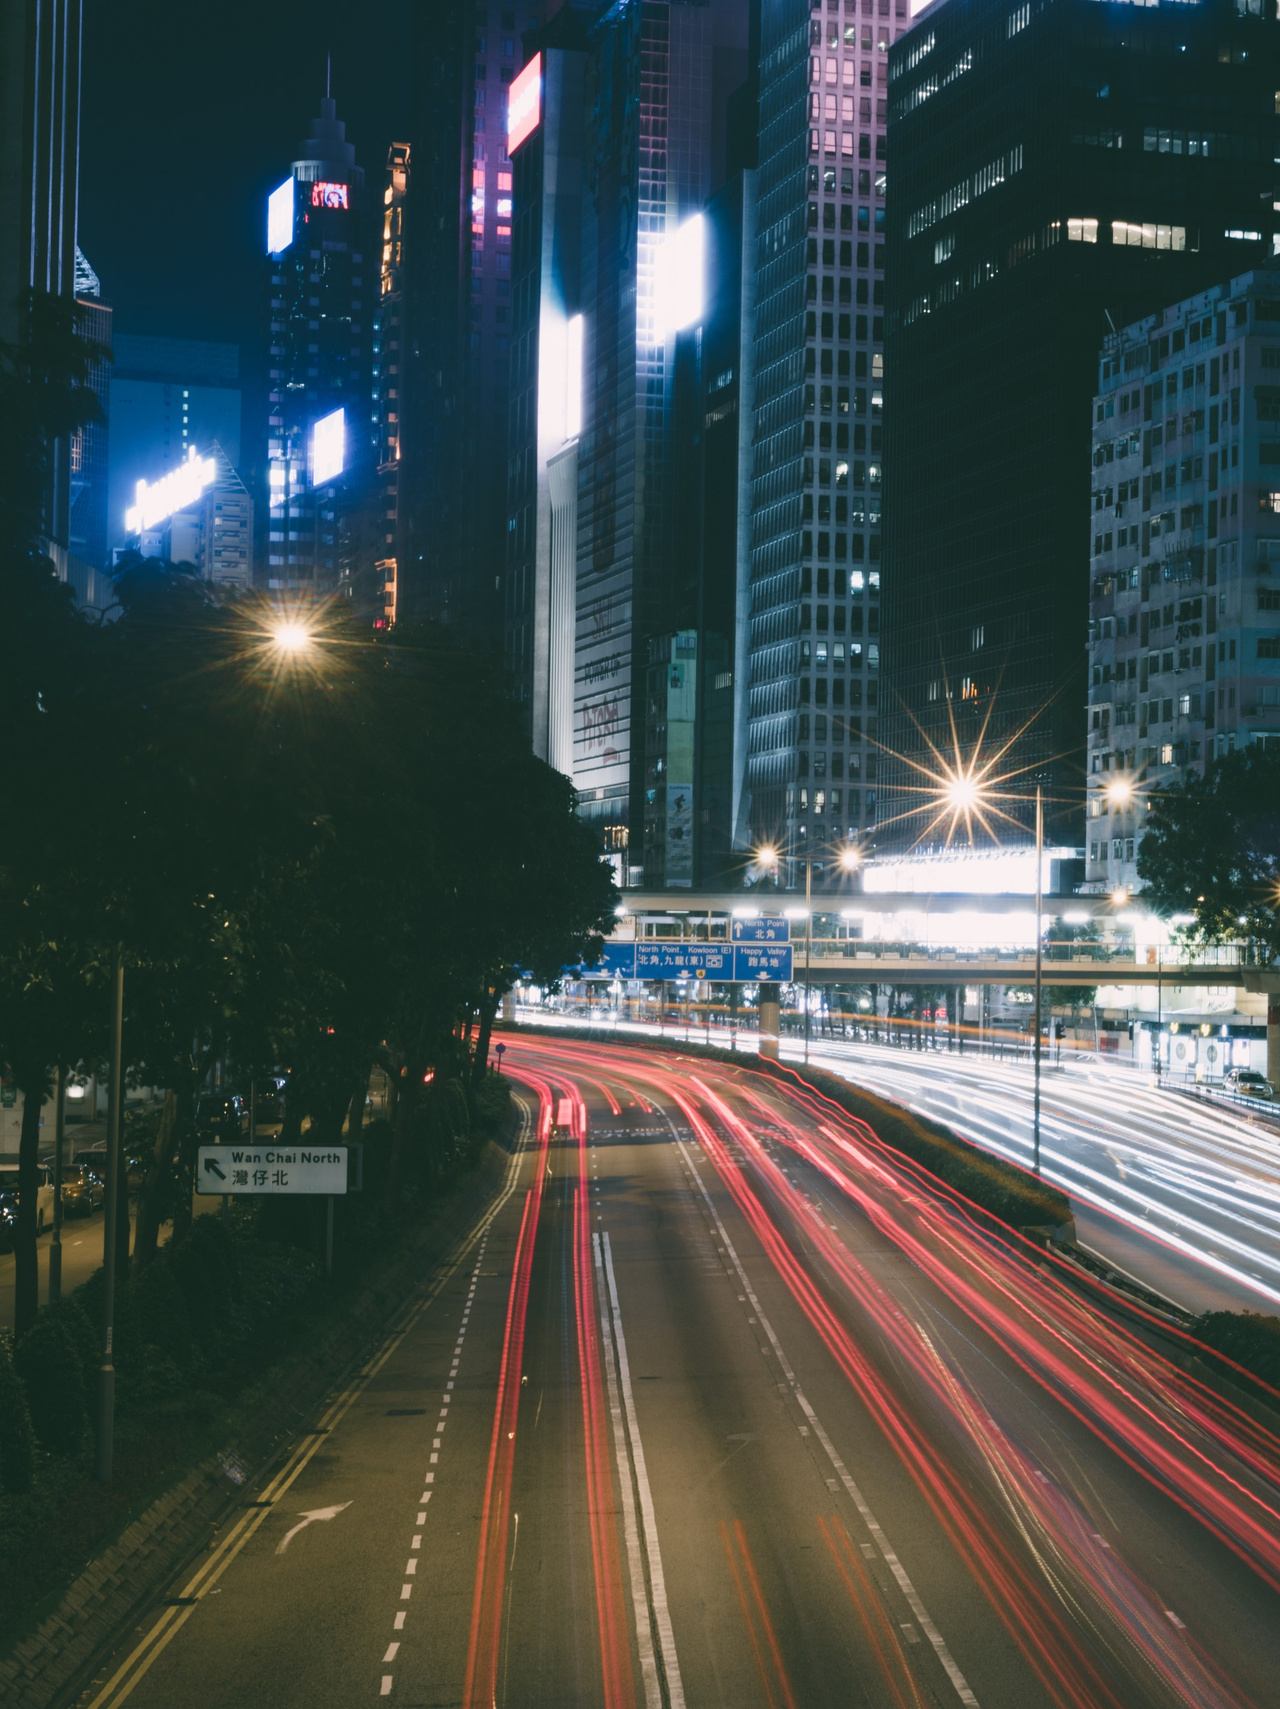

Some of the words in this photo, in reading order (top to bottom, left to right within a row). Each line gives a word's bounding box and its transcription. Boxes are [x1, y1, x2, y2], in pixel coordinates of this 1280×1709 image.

[584, 656, 609, 686] POWER
[610, 652, 621, 678] OF
[755, 929, 775, 939] 北角
[638, 945, 659, 954] North
[688, 946, 718, 954] Kowloon
[720, 946, 732, 955] (E)
[740, 947, 763, 956] Happy
[766, 948, 787, 956] Valley
[748, 956, 779, 967] 跑馬地
[231, 1151, 261, 1164] Wan
[265, 1152, 297, 1164] Chai
[301, 1152, 341, 1164] North
[232, 1169, 289, 1186] 灣仔北
